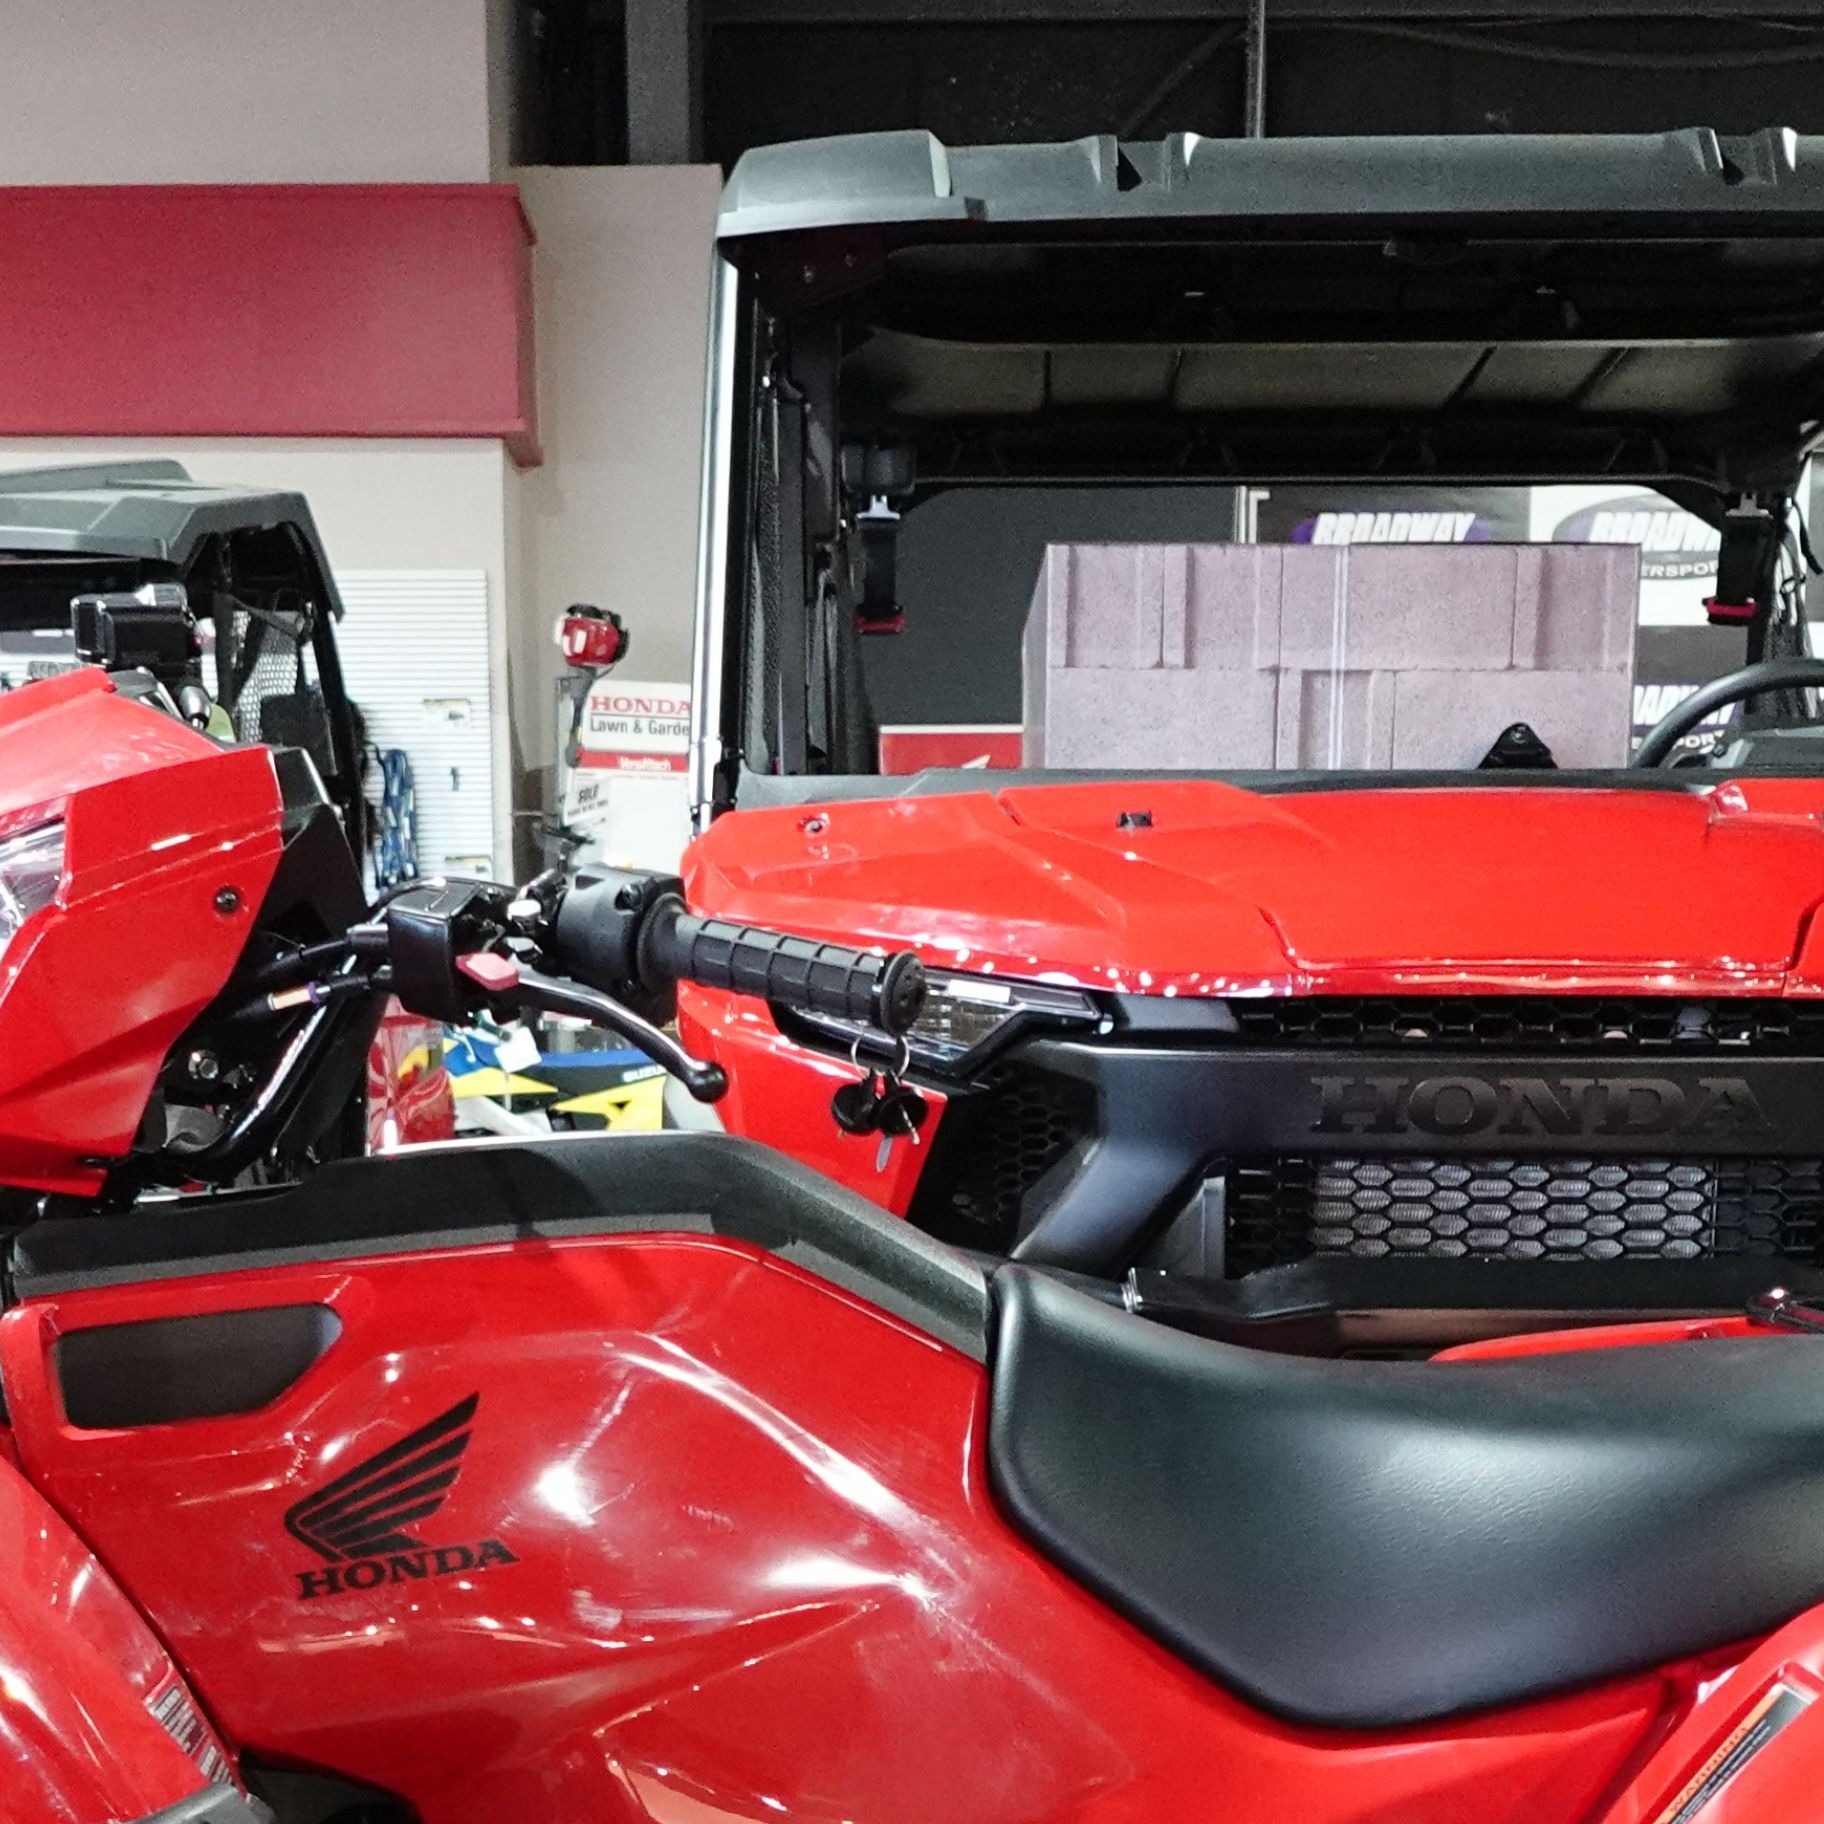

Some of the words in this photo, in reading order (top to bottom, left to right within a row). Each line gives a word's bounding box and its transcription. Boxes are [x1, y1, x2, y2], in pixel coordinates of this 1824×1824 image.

[1310, 512, 1475, 544] BROADWAY
[590, 717, 627, 733] Lawn
[633, 719, 643, 734] &
[648, 719, 690, 736] Garde
[1309, 1075, 1776, 1137] HONDA
[295, 1538, 521, 1600] HONDA
[1668, 1725, 1749, 1813] WARNING
